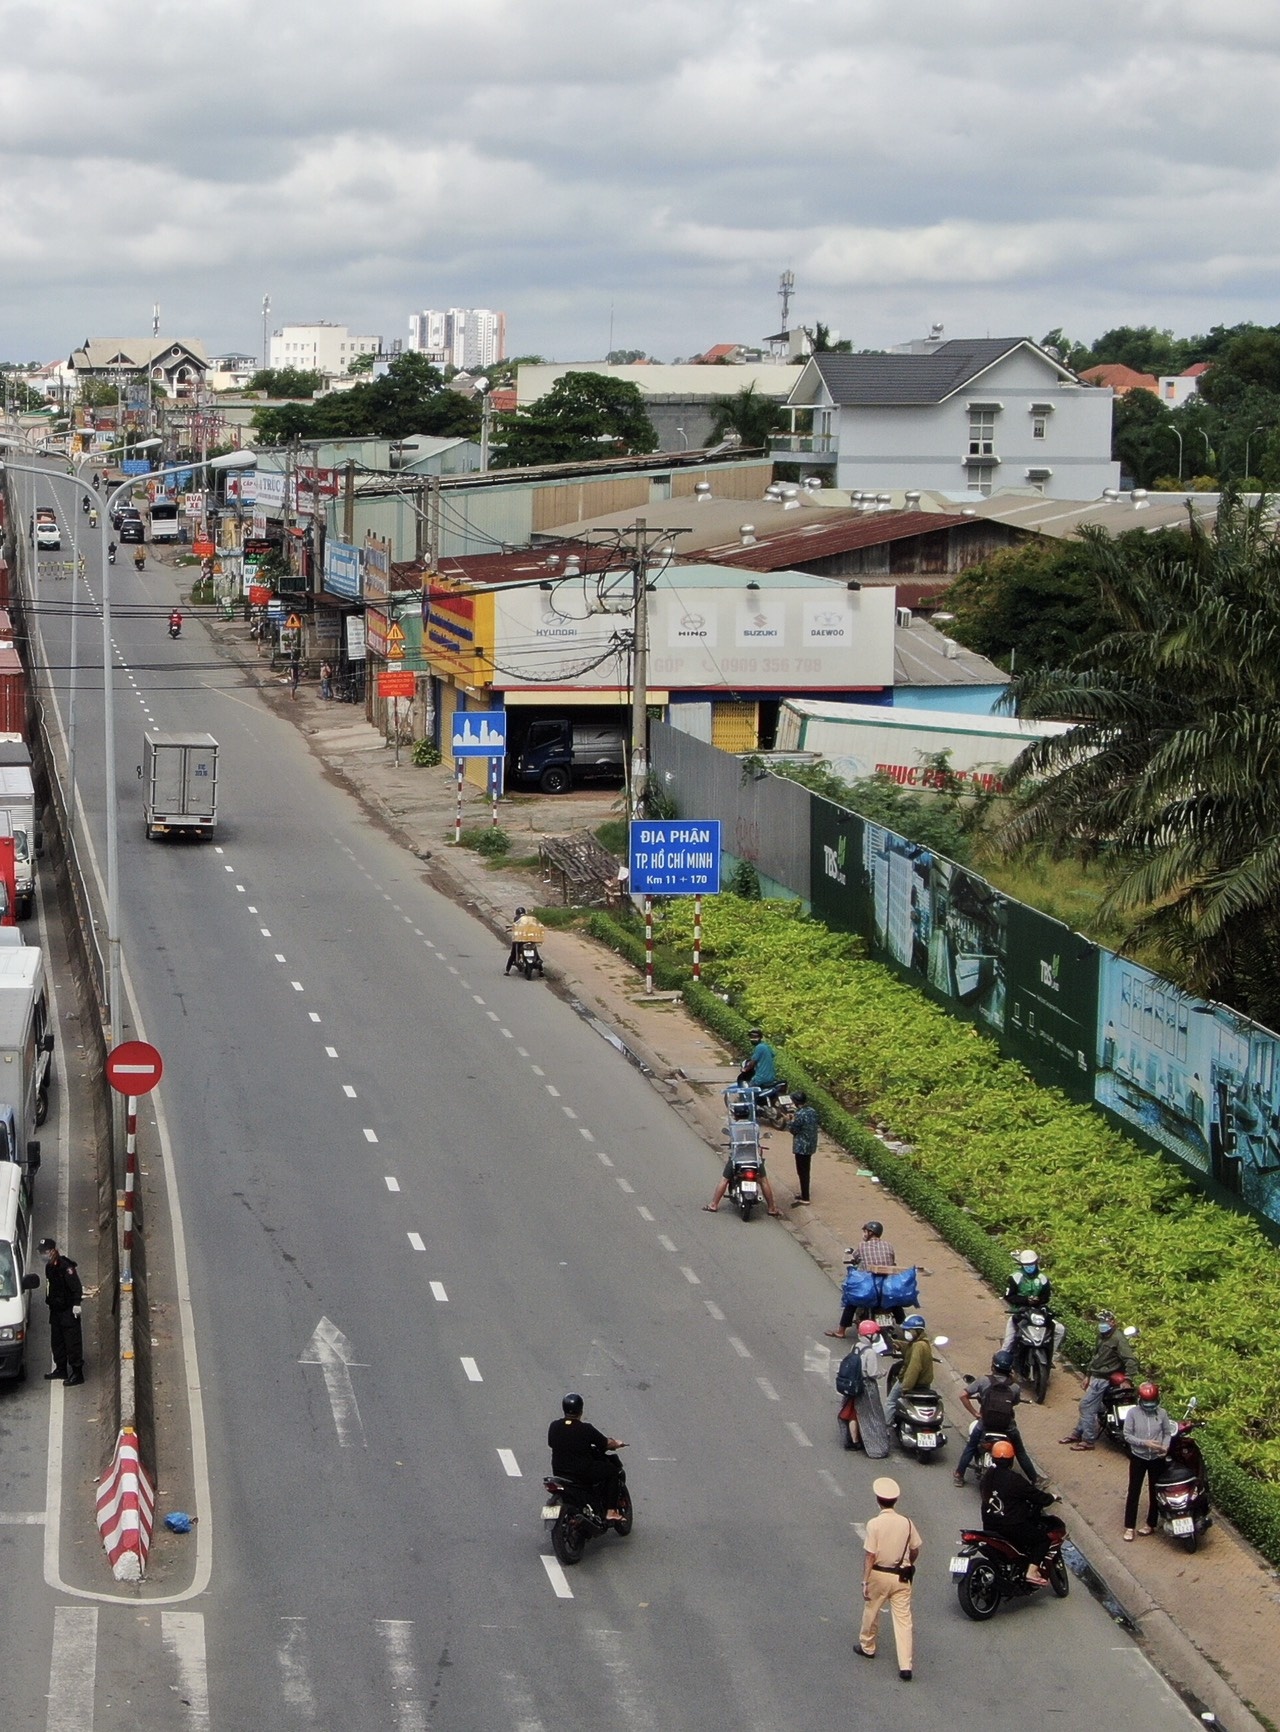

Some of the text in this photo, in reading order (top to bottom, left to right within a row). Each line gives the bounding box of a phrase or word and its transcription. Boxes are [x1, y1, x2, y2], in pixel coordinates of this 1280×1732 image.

[640, 828, 710, 845] ĐỊA PHẬN
[635, 853, 648, 869] TP.
[667, 849, 685, 869] CHÍ
[687, 852, 713, 869] MINH
[646, 875, 663, 884] Km
[666, 875, 676, 884] 11
[690, 875, 708, 884] 170
